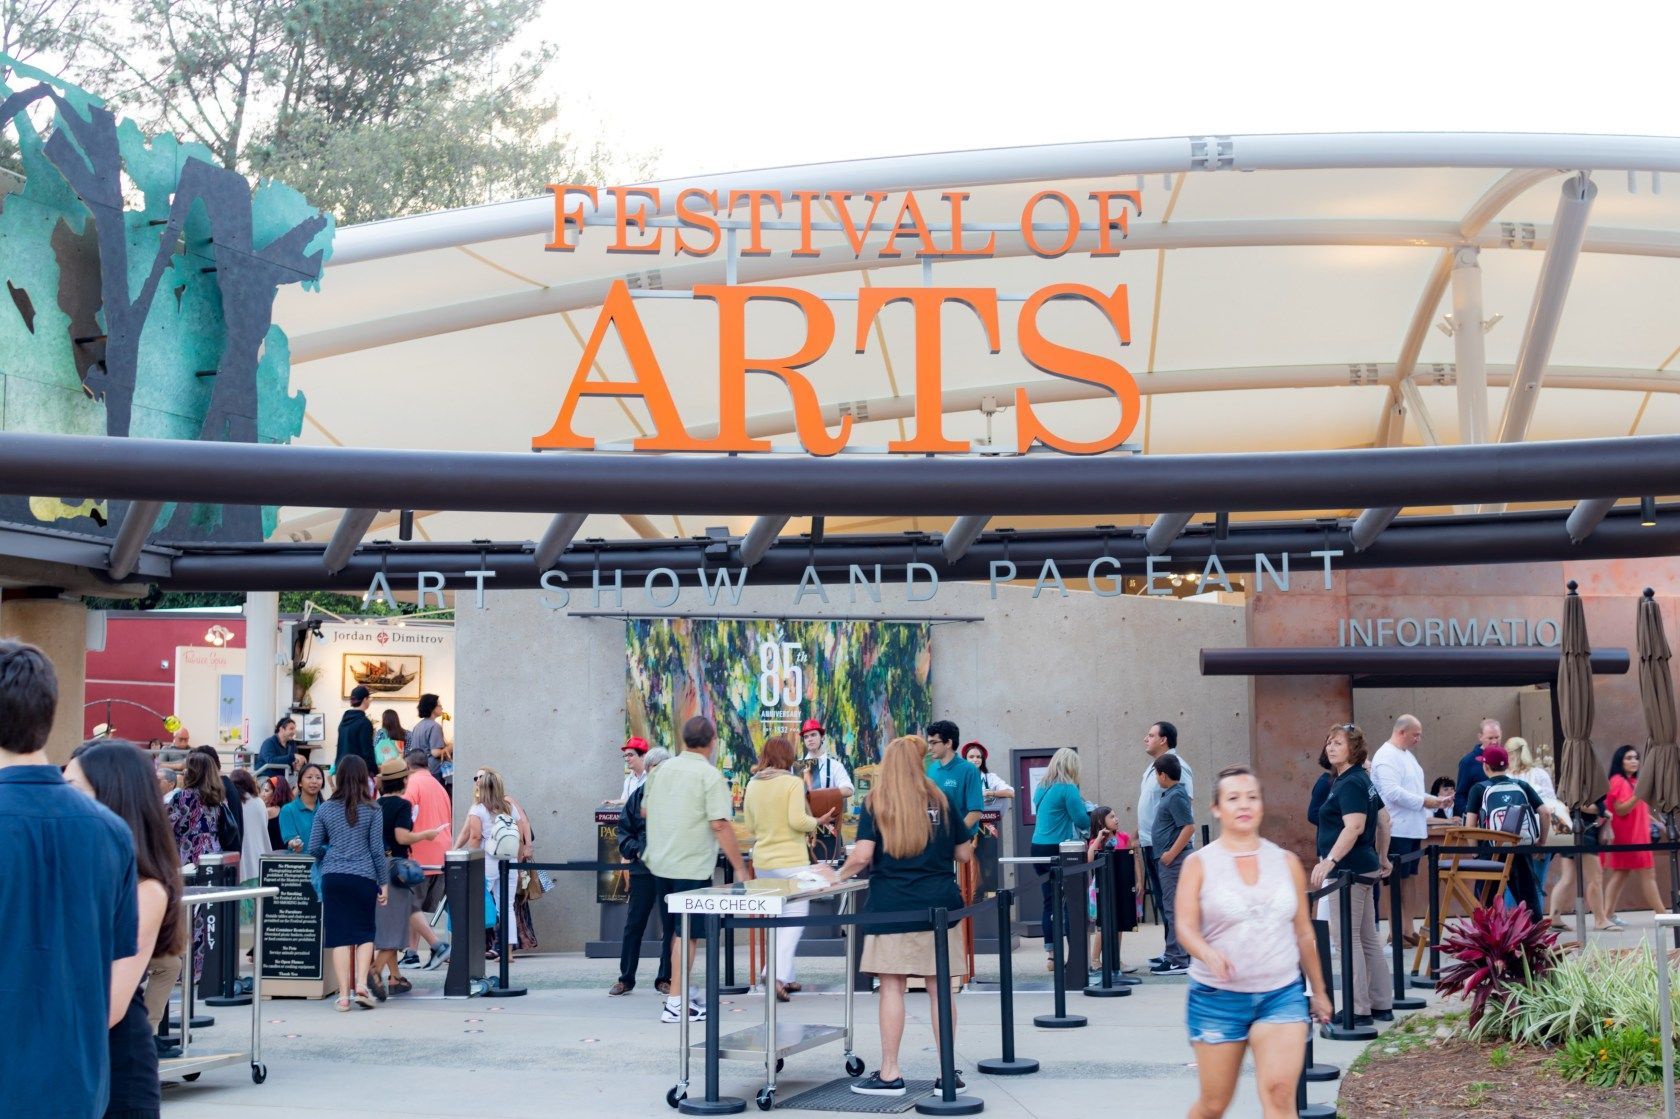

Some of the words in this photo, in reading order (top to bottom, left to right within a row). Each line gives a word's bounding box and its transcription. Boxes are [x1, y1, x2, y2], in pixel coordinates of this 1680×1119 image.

[544, 184, 995, 259] FESTIVAL
[1020, 190, 1142, 259] OF
[532, 279, 1140, 456] ARTS
[361, 570, 496, 610] ART
[539, 566, 748, 611] SHOW
[793, 562, 939, 605] AND
[989, 550, 1344, 600] PAGEANT
[334, 630, 372, 642] Jordan
[392, 632, 444, 644] Dimitrov
[1338, 617, 1562, 648] INFORMATIO
[685, 898, 715, 910] BAG
[720, 899, 766, 911] CHECK
[206, 914, 216, 950] ONLY
